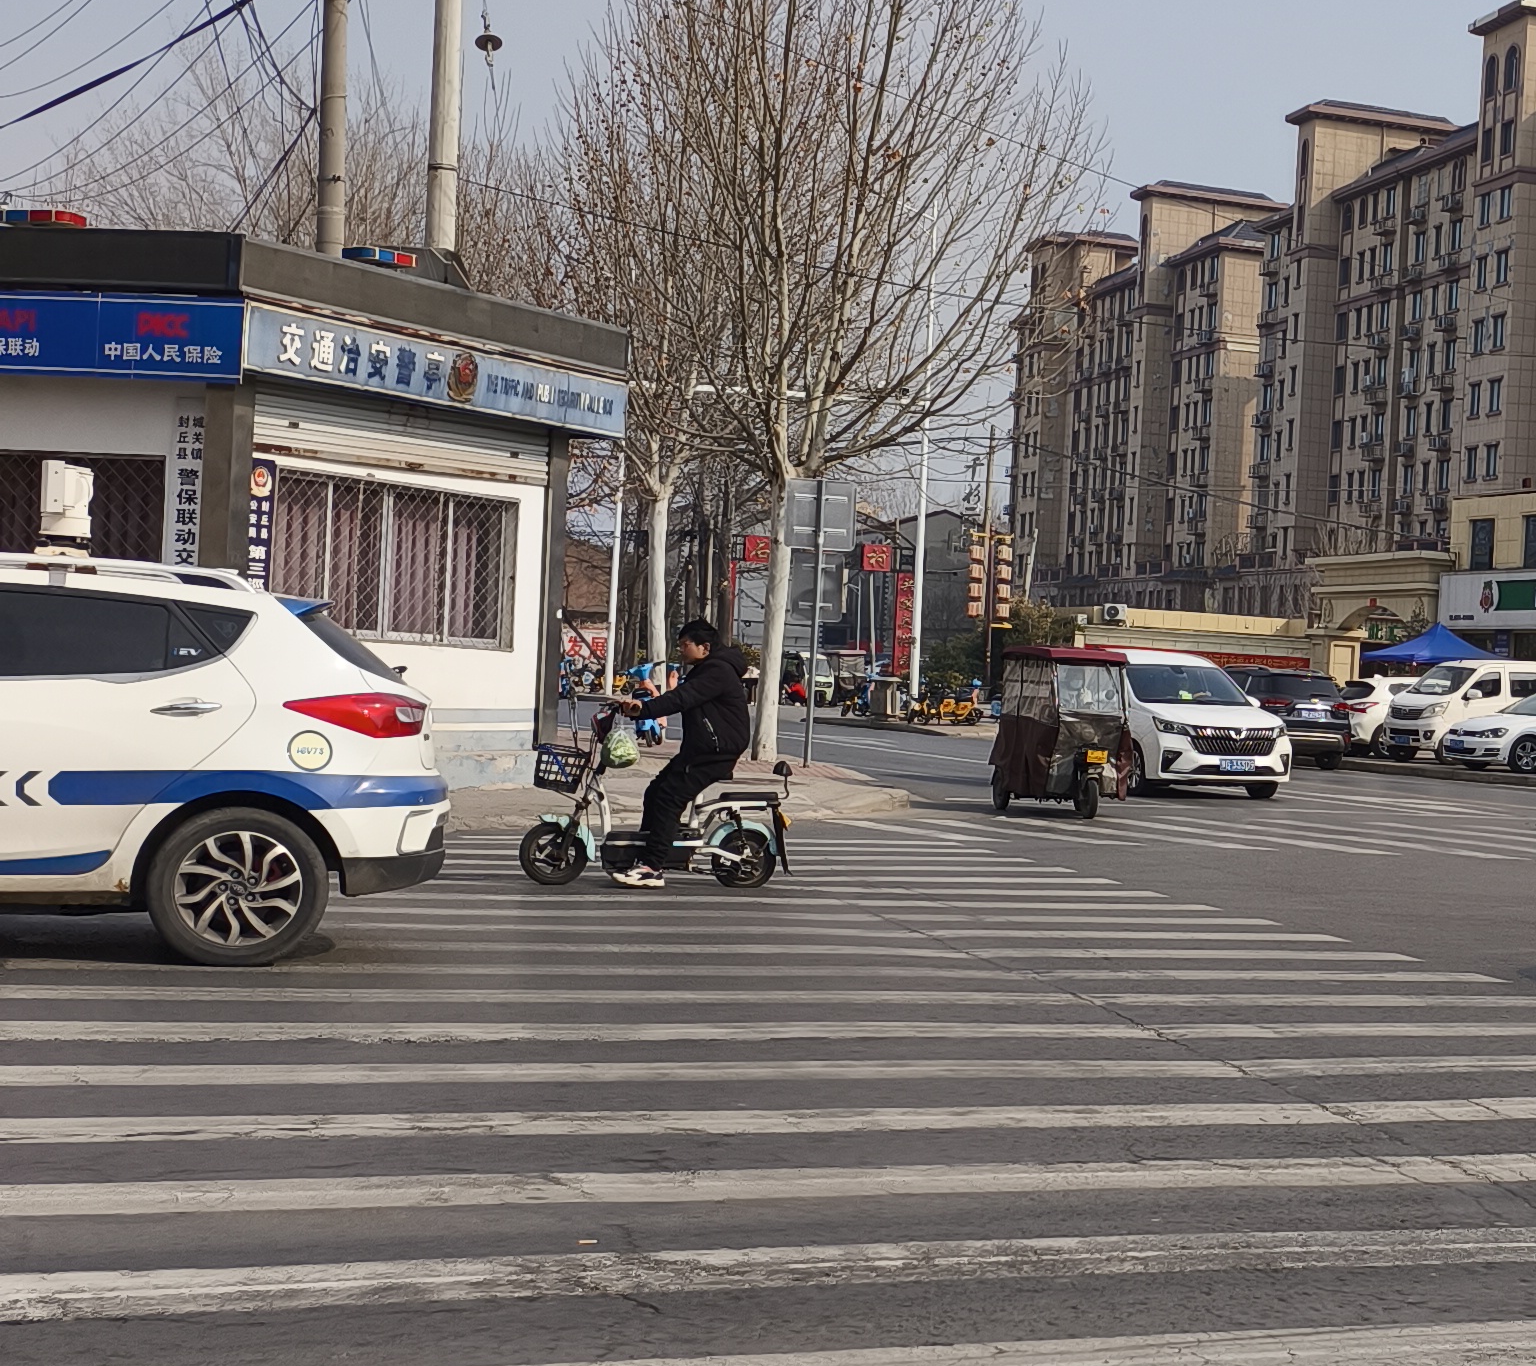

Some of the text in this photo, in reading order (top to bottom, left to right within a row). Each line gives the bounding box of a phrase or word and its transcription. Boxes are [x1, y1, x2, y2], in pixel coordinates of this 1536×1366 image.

[137, 312, 190, 338] PICC
[104, 341, 223, 364] 中国人民保险
[279, 322, 446, 391] 交通治安警亭
[176, 415, 190, 460] 封丘县
[191, 416, 206, 461] 城关镇
[174, 468, 200, 566] 警保联动交
